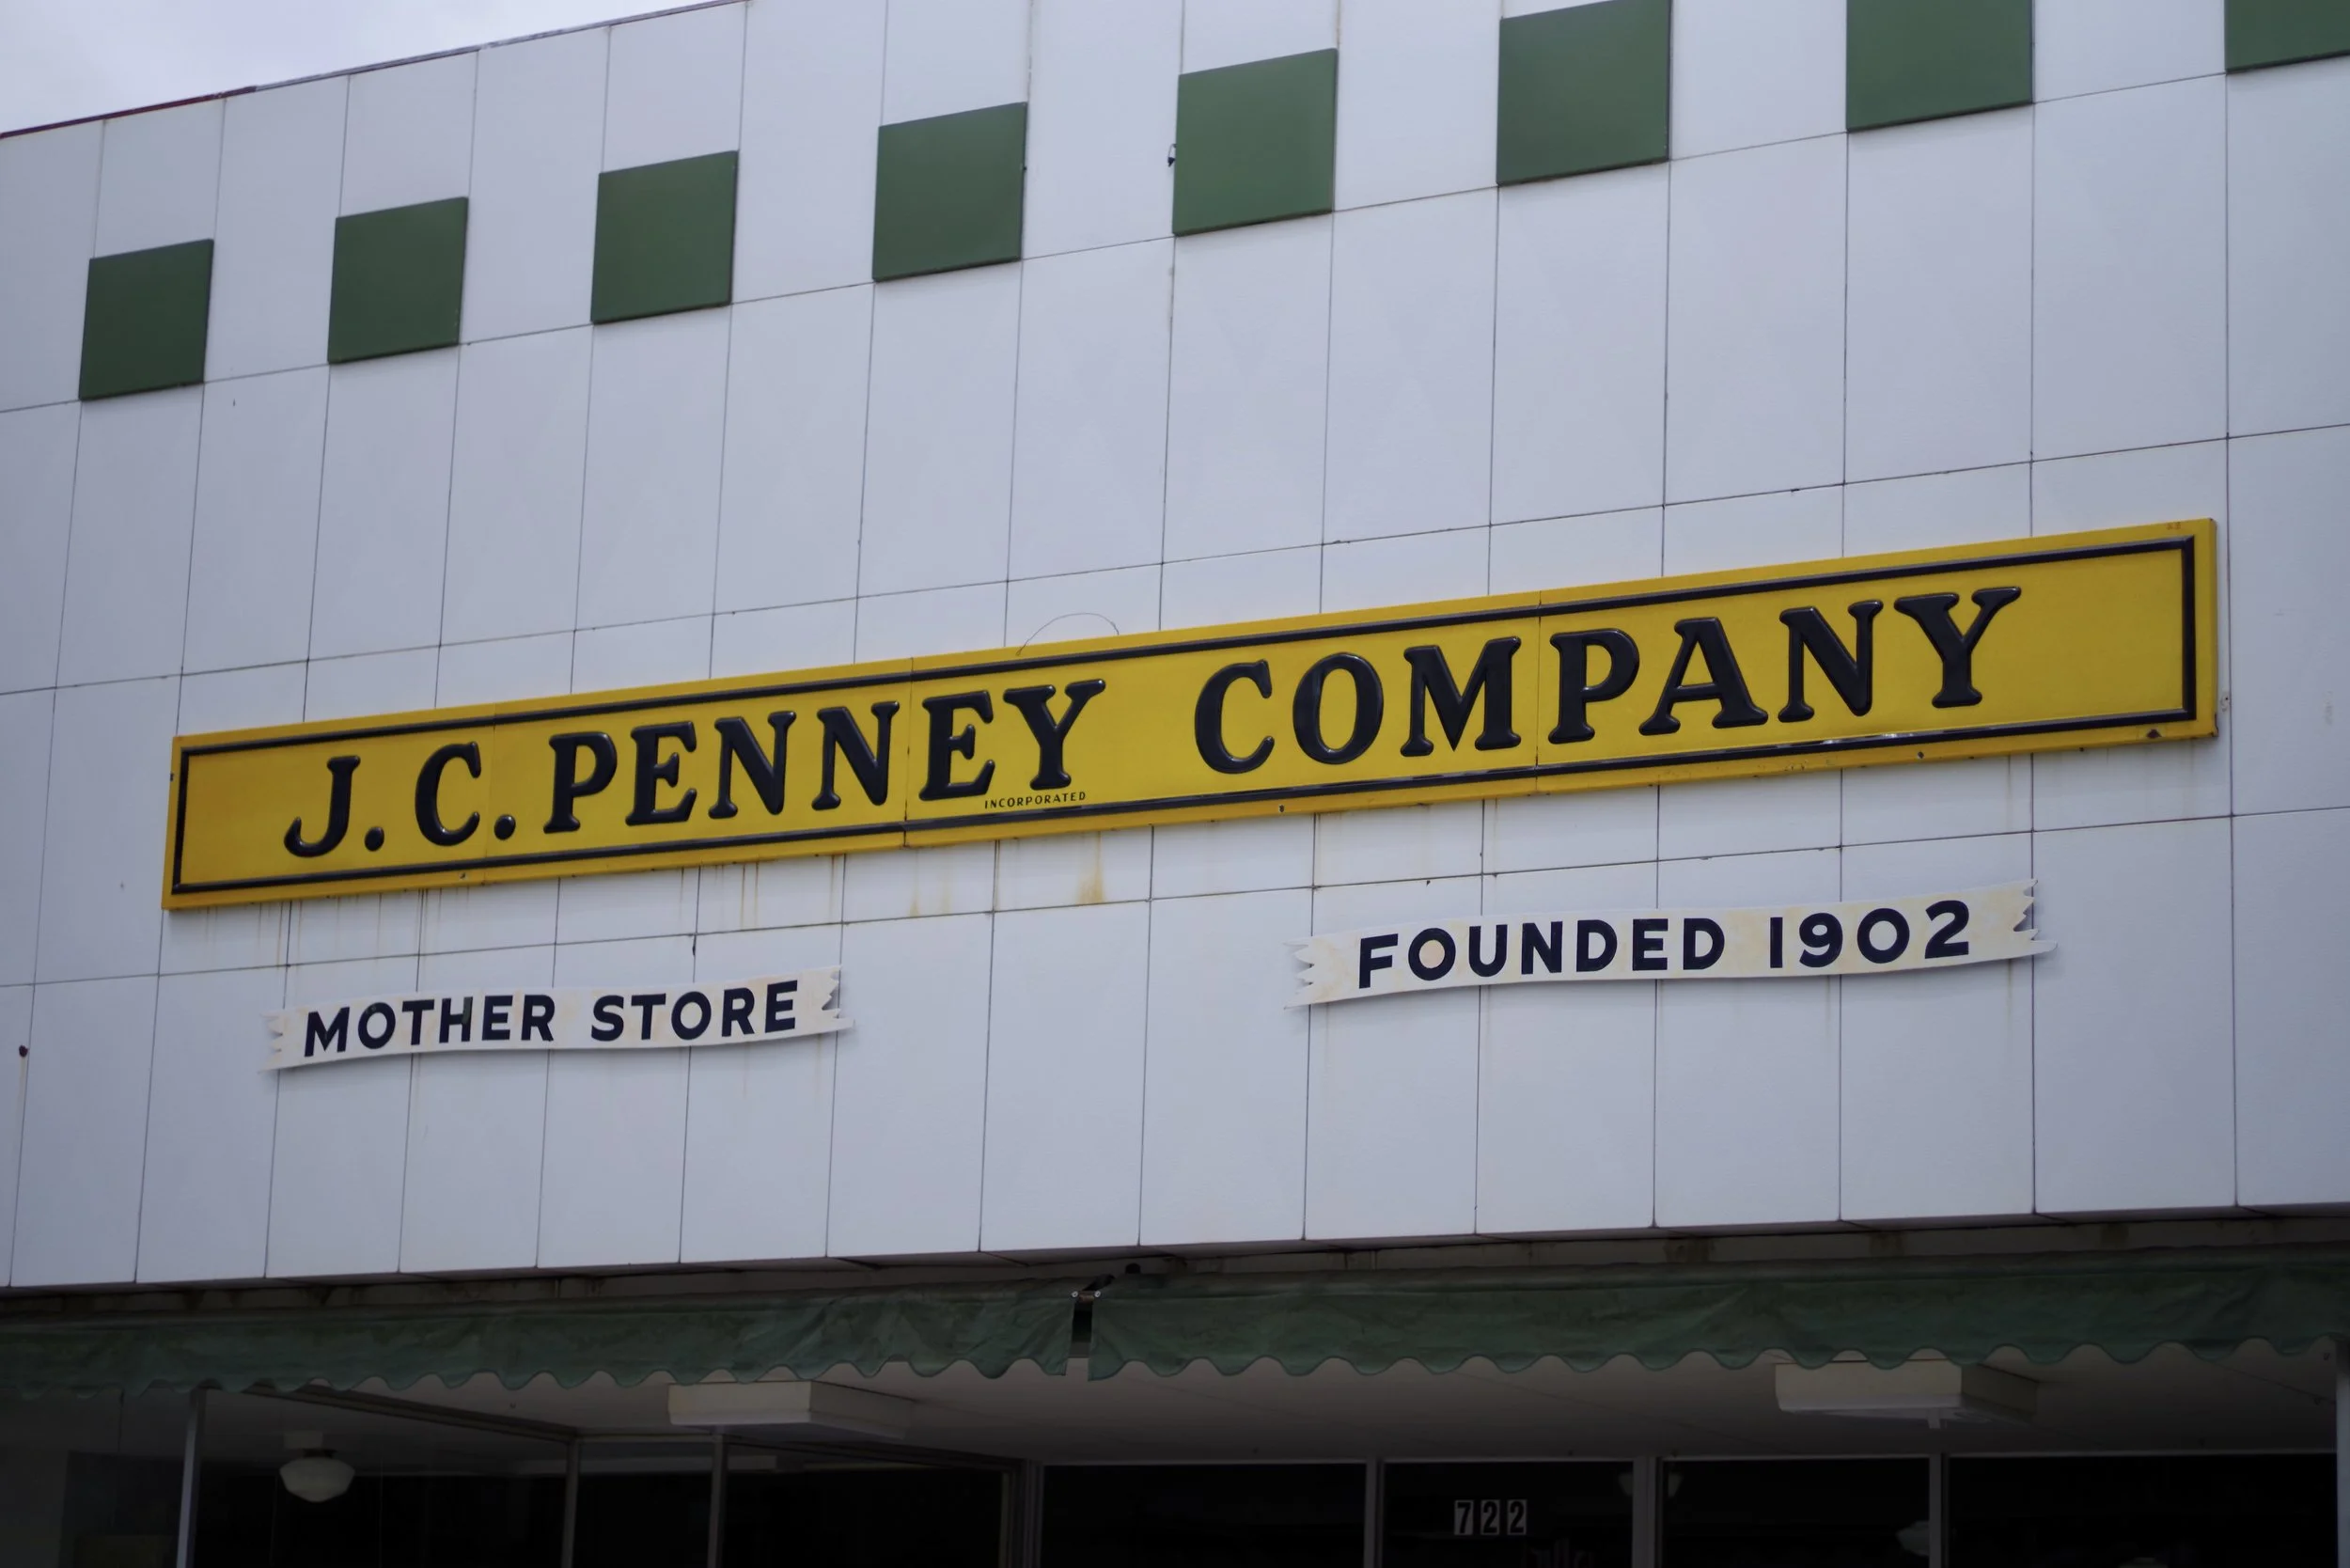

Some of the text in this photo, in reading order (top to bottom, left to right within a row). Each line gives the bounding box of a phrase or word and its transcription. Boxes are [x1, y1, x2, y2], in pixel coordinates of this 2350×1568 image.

[1195, 587, 2023, 775] COMPANY
[984, 792, 1087, 809] INCORPORATED
[1359, 901, 1970, 989] FOUNDED 1902
[304, 980, 798, 1058] MOTHER STORE
[1456, 1500, 1526, 1534] 722
